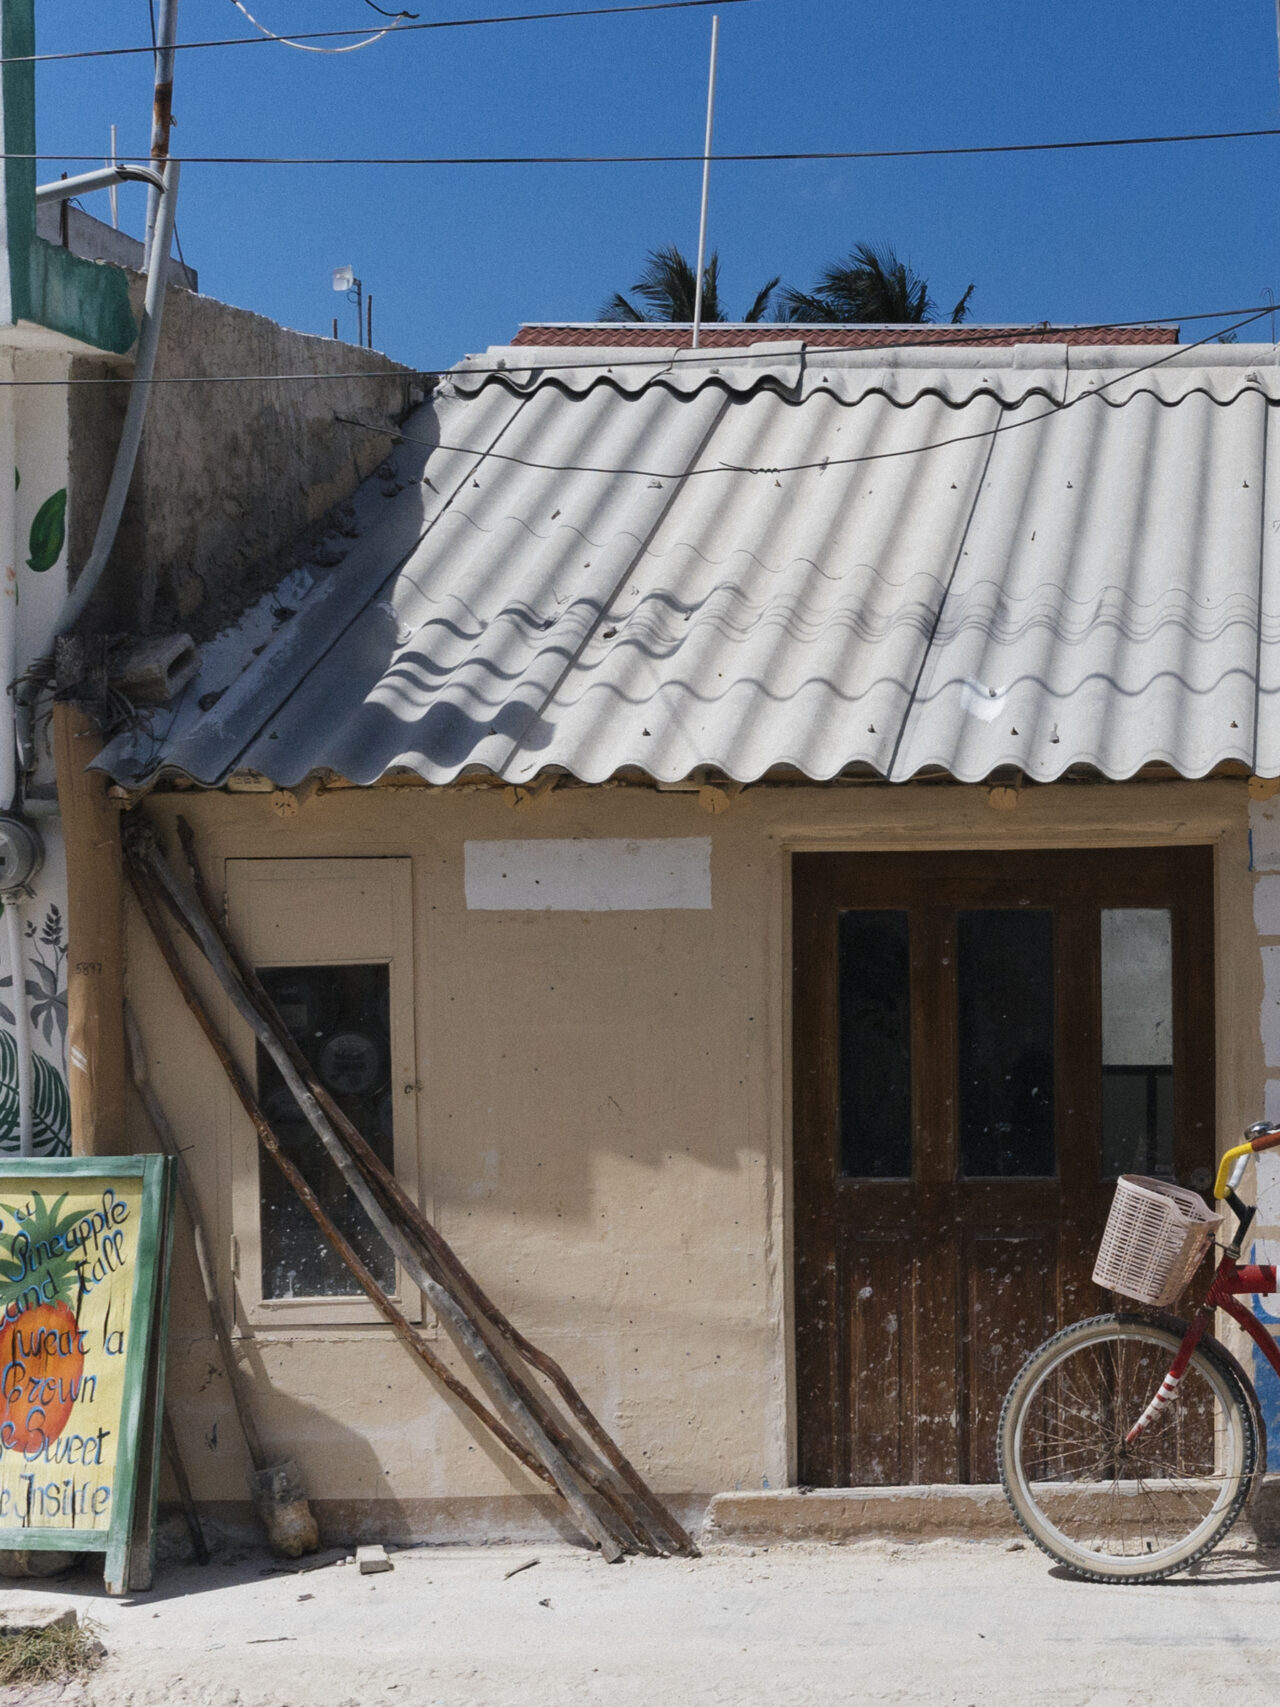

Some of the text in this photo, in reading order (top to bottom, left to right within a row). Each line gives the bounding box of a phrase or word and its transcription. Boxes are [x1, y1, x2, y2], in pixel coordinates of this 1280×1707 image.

[7, 1187, 130, 1283] Pineapple
[16, 1326, 125, 1358] wear a
[23, 1405, 110, 1466] Sweet
[15, 1474, 110, 1518] Inside
